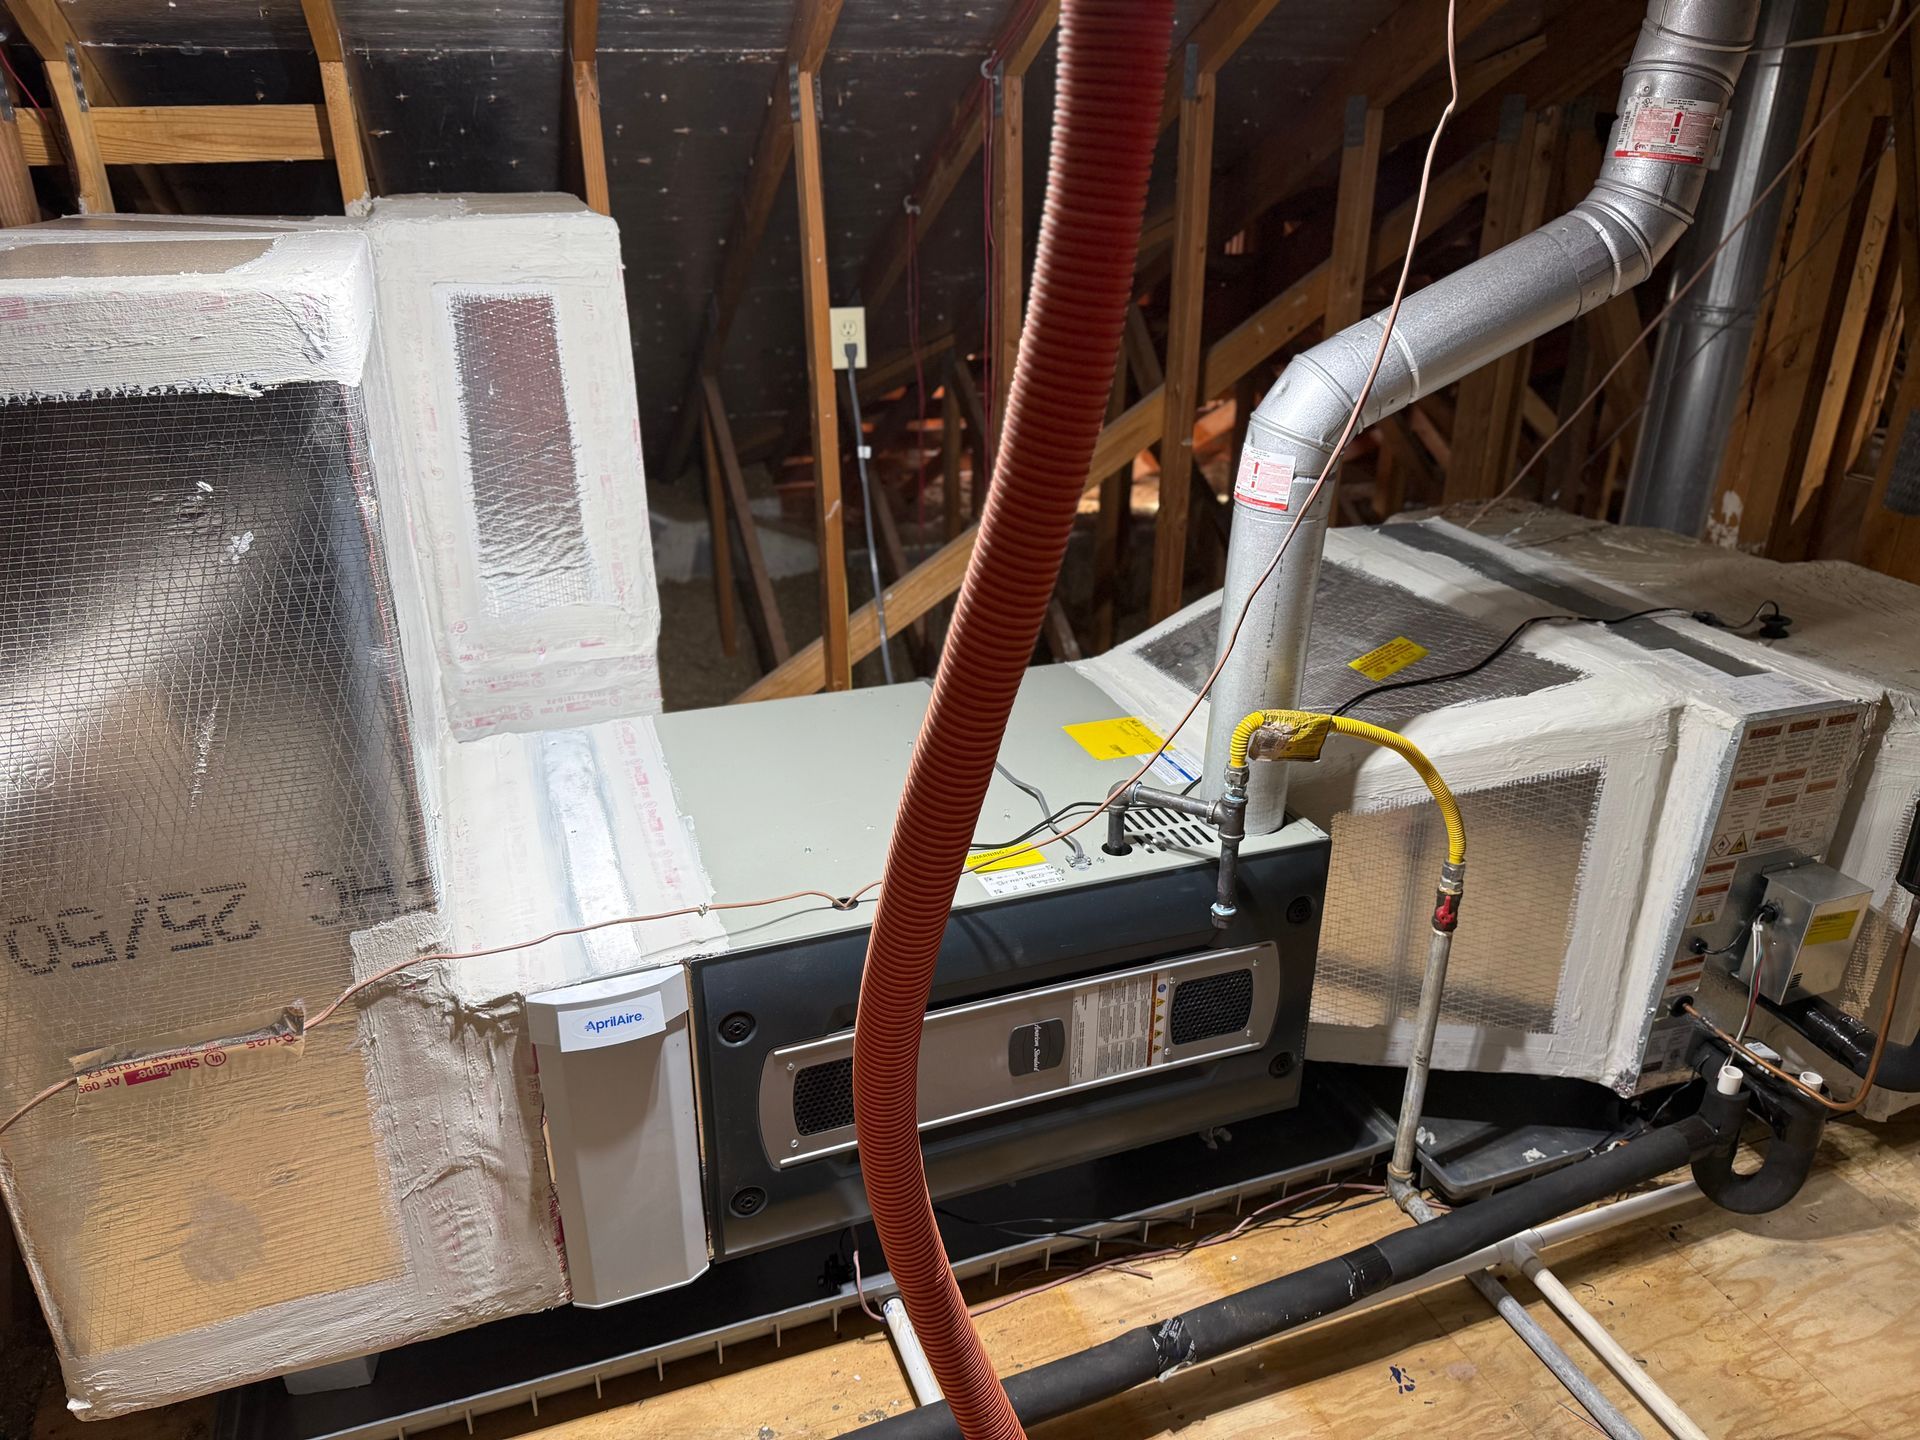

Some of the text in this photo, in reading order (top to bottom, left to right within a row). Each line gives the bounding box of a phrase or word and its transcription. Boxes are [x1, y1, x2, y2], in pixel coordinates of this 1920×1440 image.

[4, 883, 261, 977] 25/50
[585, 1011, 643, 1034] AprilAire
[79, 1057, 200, 1094] Shurtape AF 099
